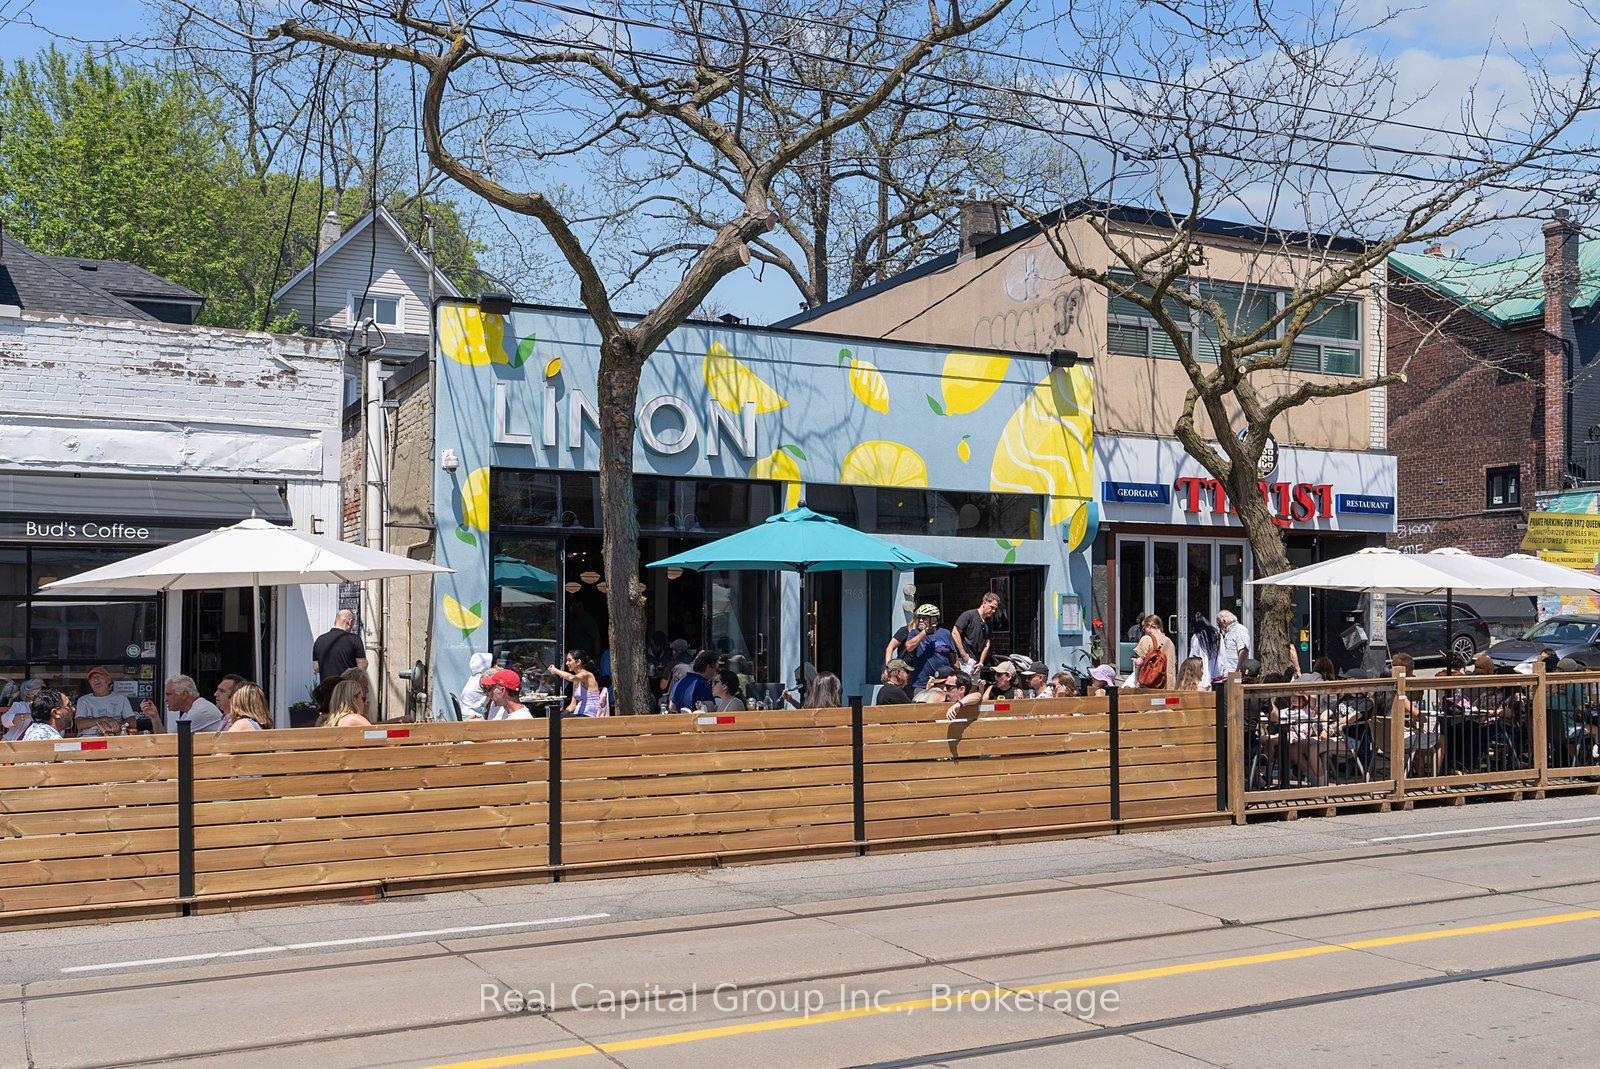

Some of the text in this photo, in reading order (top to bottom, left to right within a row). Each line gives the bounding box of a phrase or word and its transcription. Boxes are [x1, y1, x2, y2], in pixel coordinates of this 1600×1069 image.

[1117, 488, 1159, 498] GEORGIAN
[1174, 476, 1333, 528] TIISI
[1346, 500, 1389, 509] RESTAURANT
[1544, 518, 1564, 527] PARKING
[1564, 518, 1573, 527] FOR
[1574, 519, 1585, 528] 1972
[26, 521, 150, 539] Bud's Coffee
